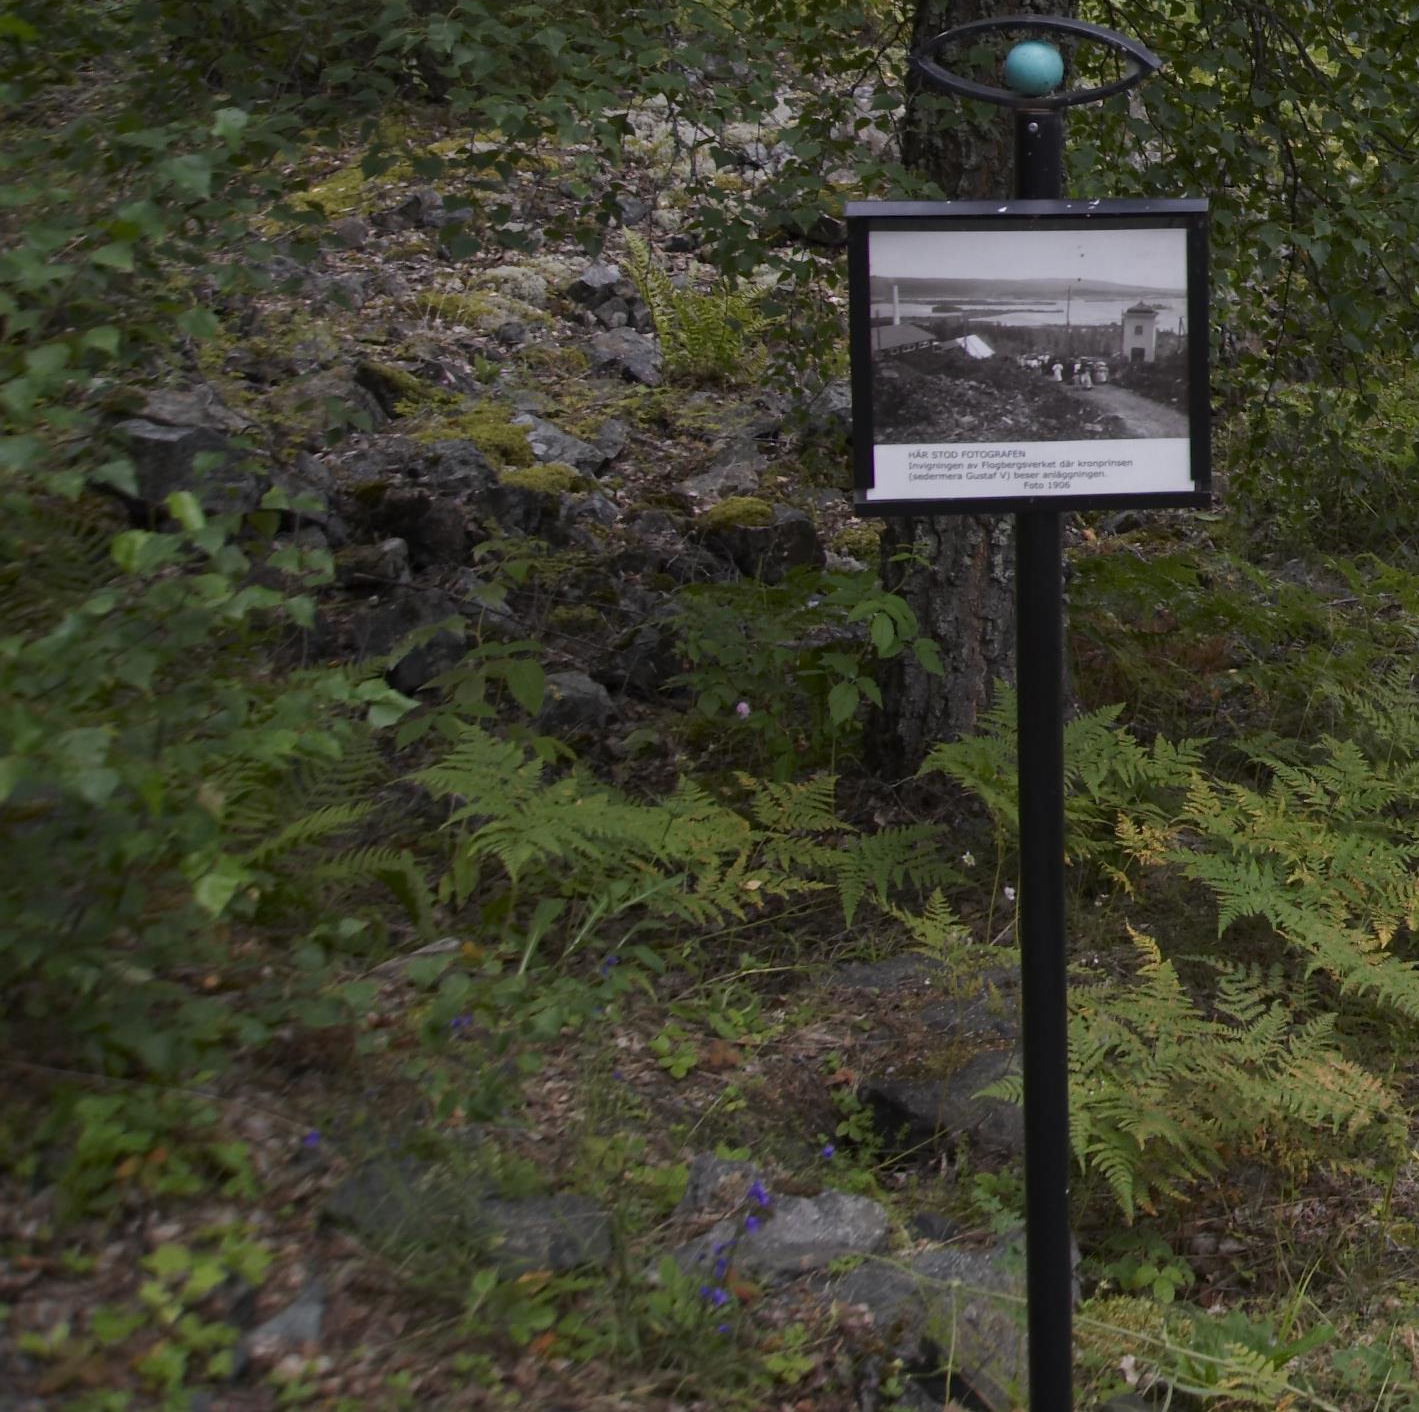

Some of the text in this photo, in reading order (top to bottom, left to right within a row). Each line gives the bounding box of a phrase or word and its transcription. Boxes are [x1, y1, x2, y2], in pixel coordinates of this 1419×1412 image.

[931, 450, 959, 459] STOD
[961, 449, 1026, 459] FOTOGRAFEN
[908, 461, 965, 471] Invigningen
[981, 460, 1056, 470] Flogbergsverket
[1059, 460, 1075, 468] där
[1077, 459, 1134, 469] kronprinsen
[908, 472, 962, 481] (sedermera
[965, 471, 997, 480] Gustaf
[999, 470, 1011, 481] V)
[1013, 471, 1040, 479] beser
[1023, 480, 1071, 489] Foto 1906
